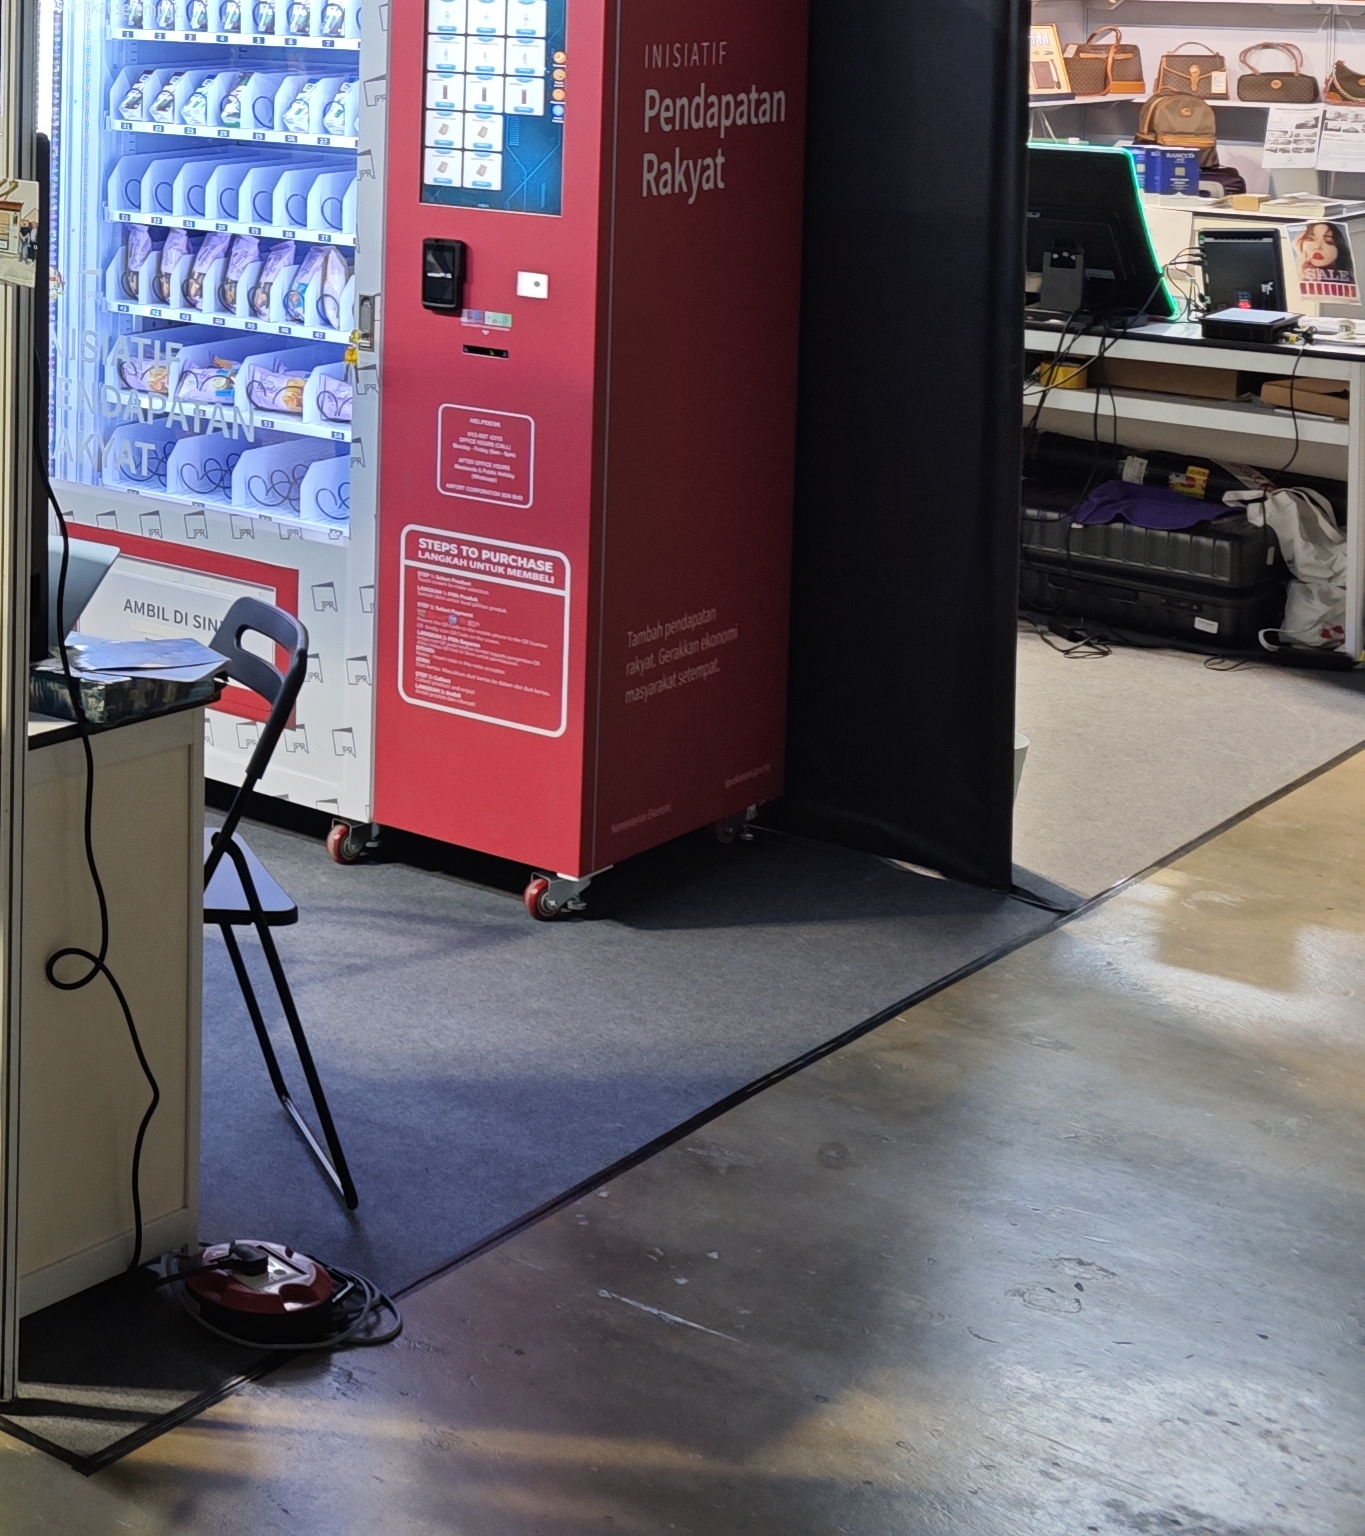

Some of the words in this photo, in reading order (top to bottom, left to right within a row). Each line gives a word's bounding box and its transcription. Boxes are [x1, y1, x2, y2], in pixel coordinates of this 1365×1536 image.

[644, 41, 728, 69] INISIATIF
[644, 82, 786, 139] Pendapatan
[642, 146, 726, 205] Rakyat
[1304, 268, 1350, 283] SALE
[51, 328, 184, 372] NISIATIF
[57, 377, 255, 443] ENDAPATAN
[53, 429, 157, 477] AKYAT
[417, 550, 468, 567] LANGKAH
[469, 560, 506, 575] UNTUK
[507, 568, 555, 584] MEMBELI
[418, 537, 459, 555] STEPS
[460, 544, 479, 559] TO
[481, 549, 554, 574] PURCHASE
[123, 598, 170, 622] AMBIL
[173, 609, 189, 627] DI
[192, 614, 224, 634] SIN
[626, 620, 664, 649] Tambah
[664, 607, 718, 642] pendapatan
[625, 651, 657, 678] rakyat.
[657, 637, 700, 666] Gerakkan
[700, 622, 739, 652] ekonomi
[624, 669, 678, 704] masyarakat
